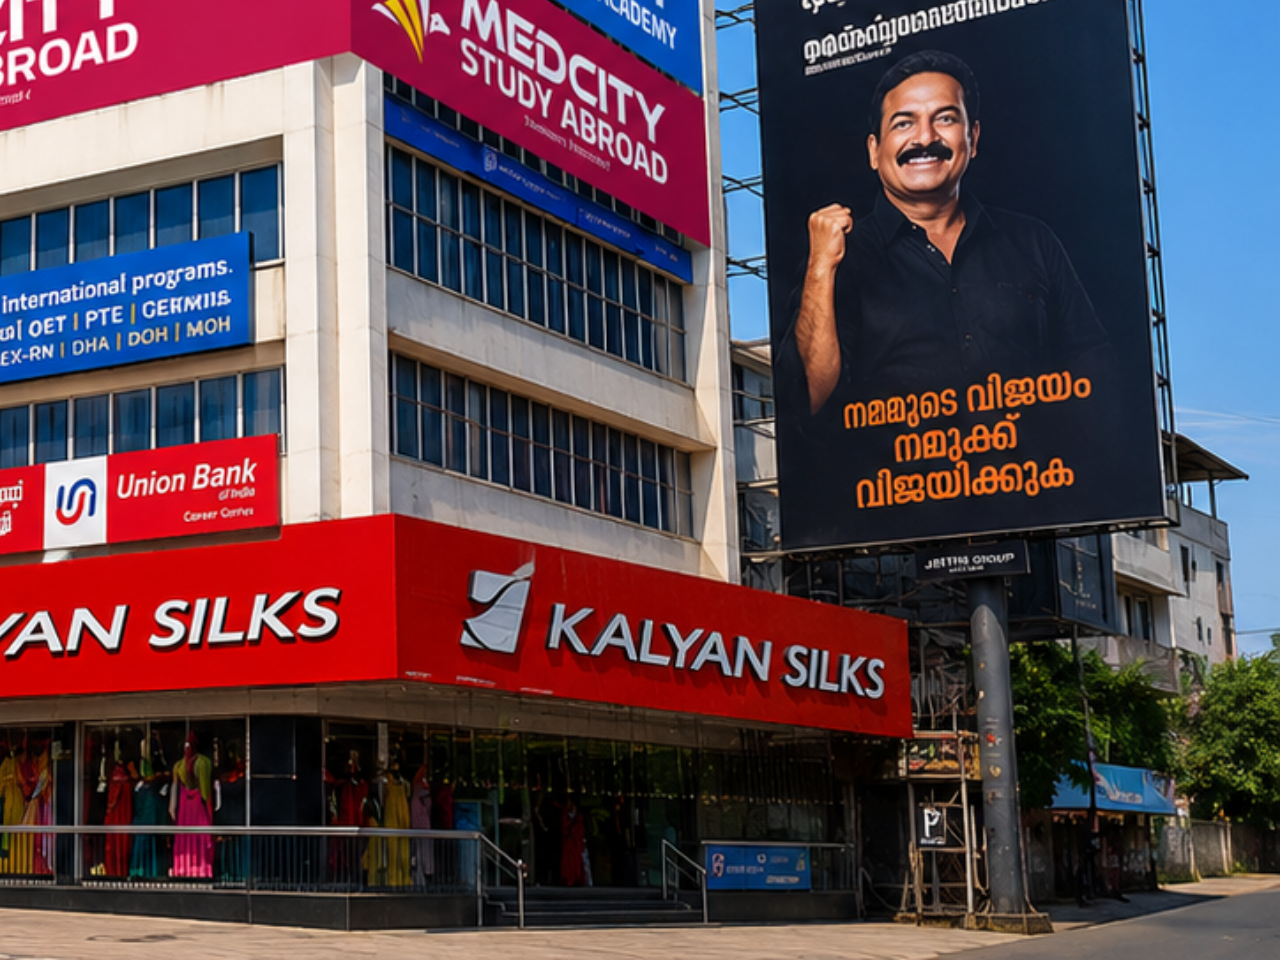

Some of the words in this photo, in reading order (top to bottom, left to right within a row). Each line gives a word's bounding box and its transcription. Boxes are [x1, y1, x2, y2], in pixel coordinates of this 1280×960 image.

[461, 38, 553, 119] STUDY
[560, 99, 668, 186] ABROAD
[1, 272, 127, 315] international
[28, 314, 68, 339] OET
[86, 305, 124, 330] PTE
[72, 335, 110, 356] DHA
[128, 325, 168, 347] DOH
[186, 315, 231, 338] MOH
[967, 371, 1092, 412] വിജയം
[894, 412, 1021, 462] നമുക്ക്
[117, 470, 186, 499] Union
[192, 457, 257, 490] Bank
[856, 457, 1075, 508] വിജയിക്കുക
[148, 586, 341, 649] SILKS
[547, 603, 773, 682] KALYAN
[783, 644, 886, 700] SILKS
